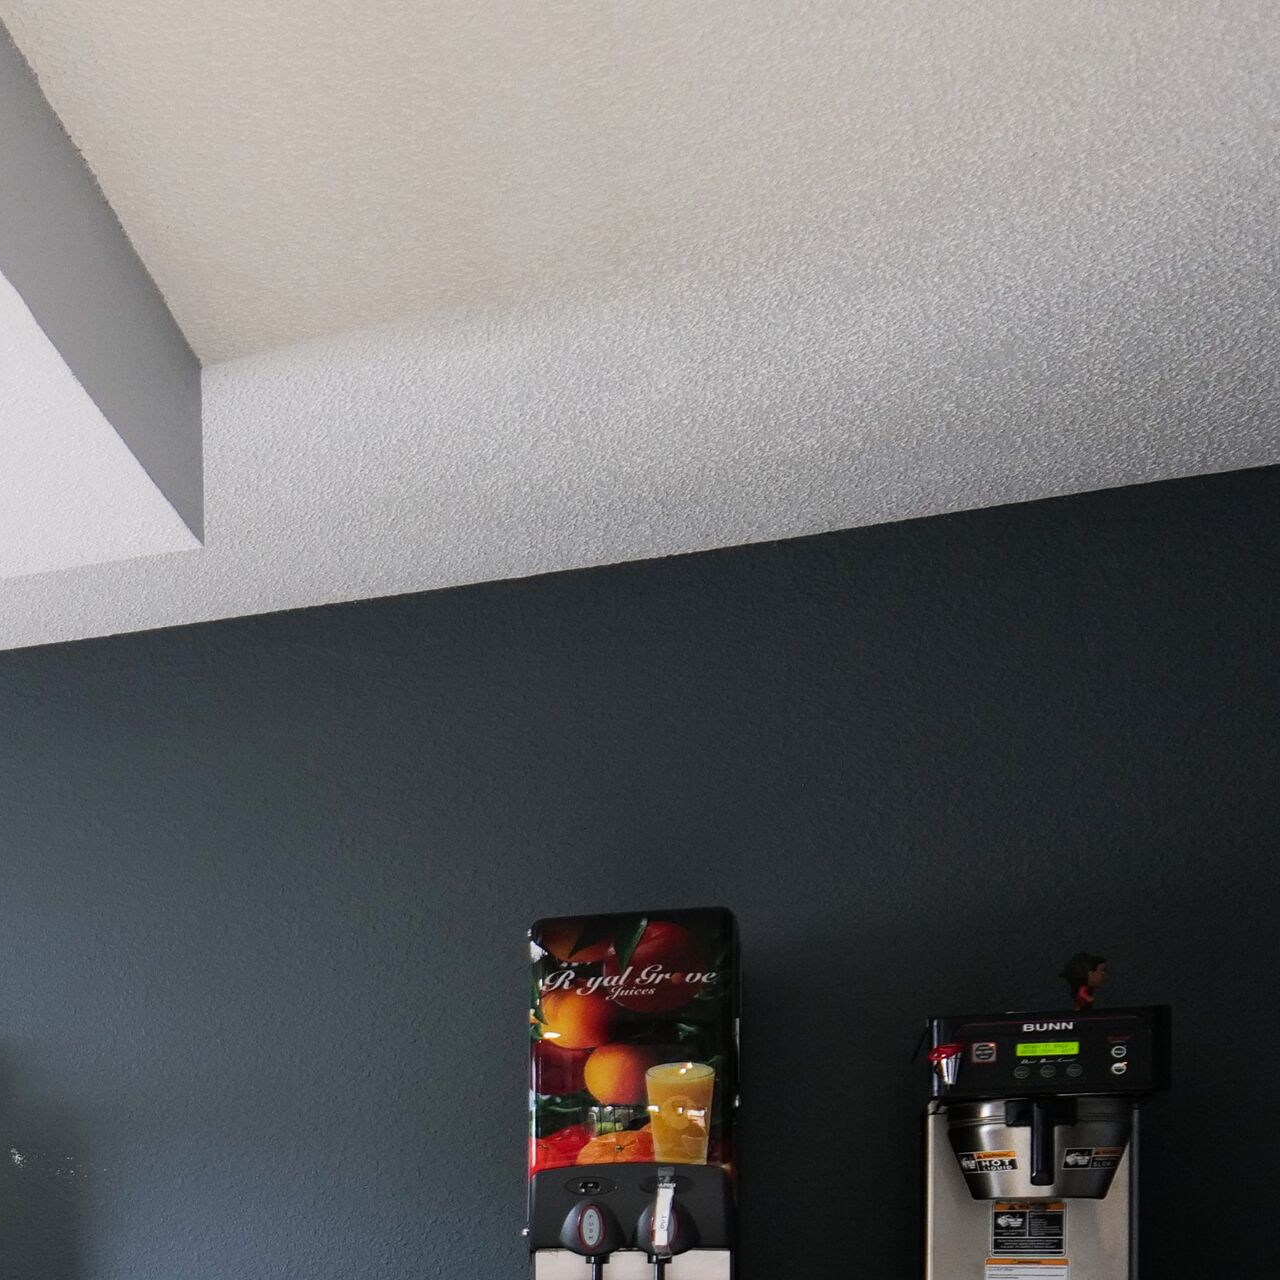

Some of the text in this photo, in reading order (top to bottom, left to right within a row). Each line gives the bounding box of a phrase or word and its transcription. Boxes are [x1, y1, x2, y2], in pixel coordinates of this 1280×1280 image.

[542, 964, 718, 996] Royal Grove
[605, 986, 656, 1001] Juices
[1023, 1022, 1074, 1032] BUNN
